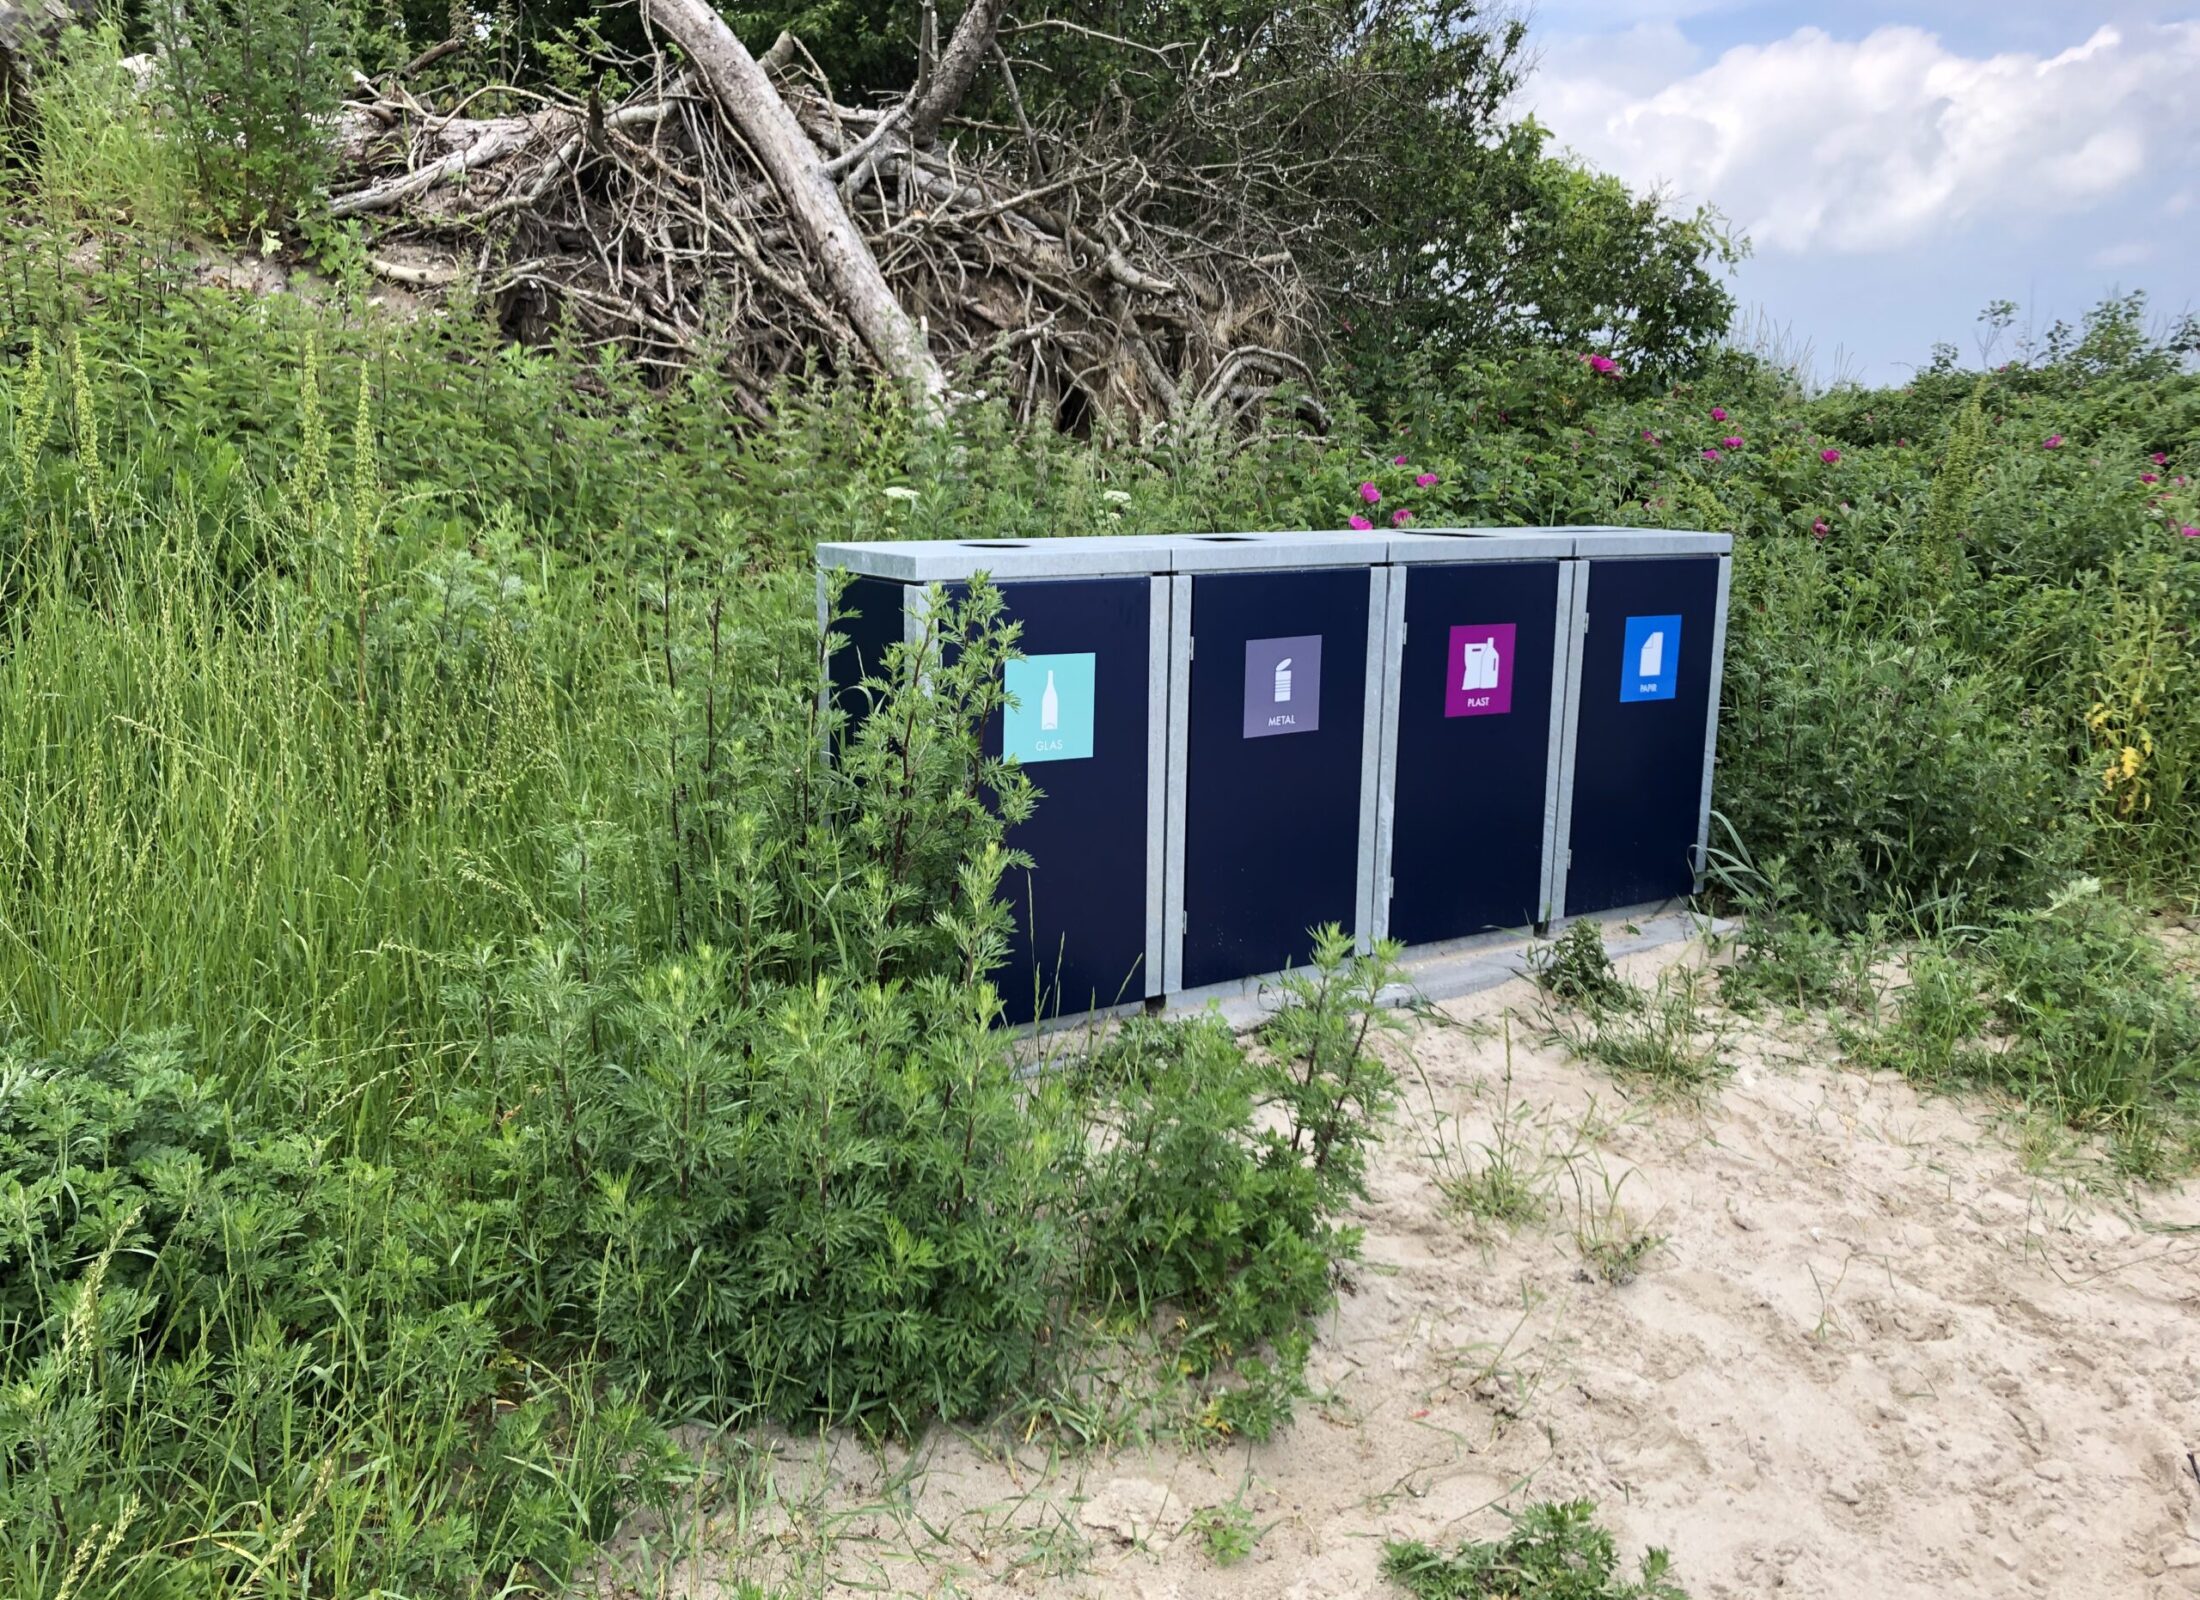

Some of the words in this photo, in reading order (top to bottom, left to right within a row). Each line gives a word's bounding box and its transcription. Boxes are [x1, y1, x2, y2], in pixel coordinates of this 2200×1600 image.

[1639, 683, 1658, 693] PAPIR
[1467, 696, 1490, 708] PLAST
[1268, 714, 1296, 727] METAL
[1035, 739, 1063, 752] GLAS
